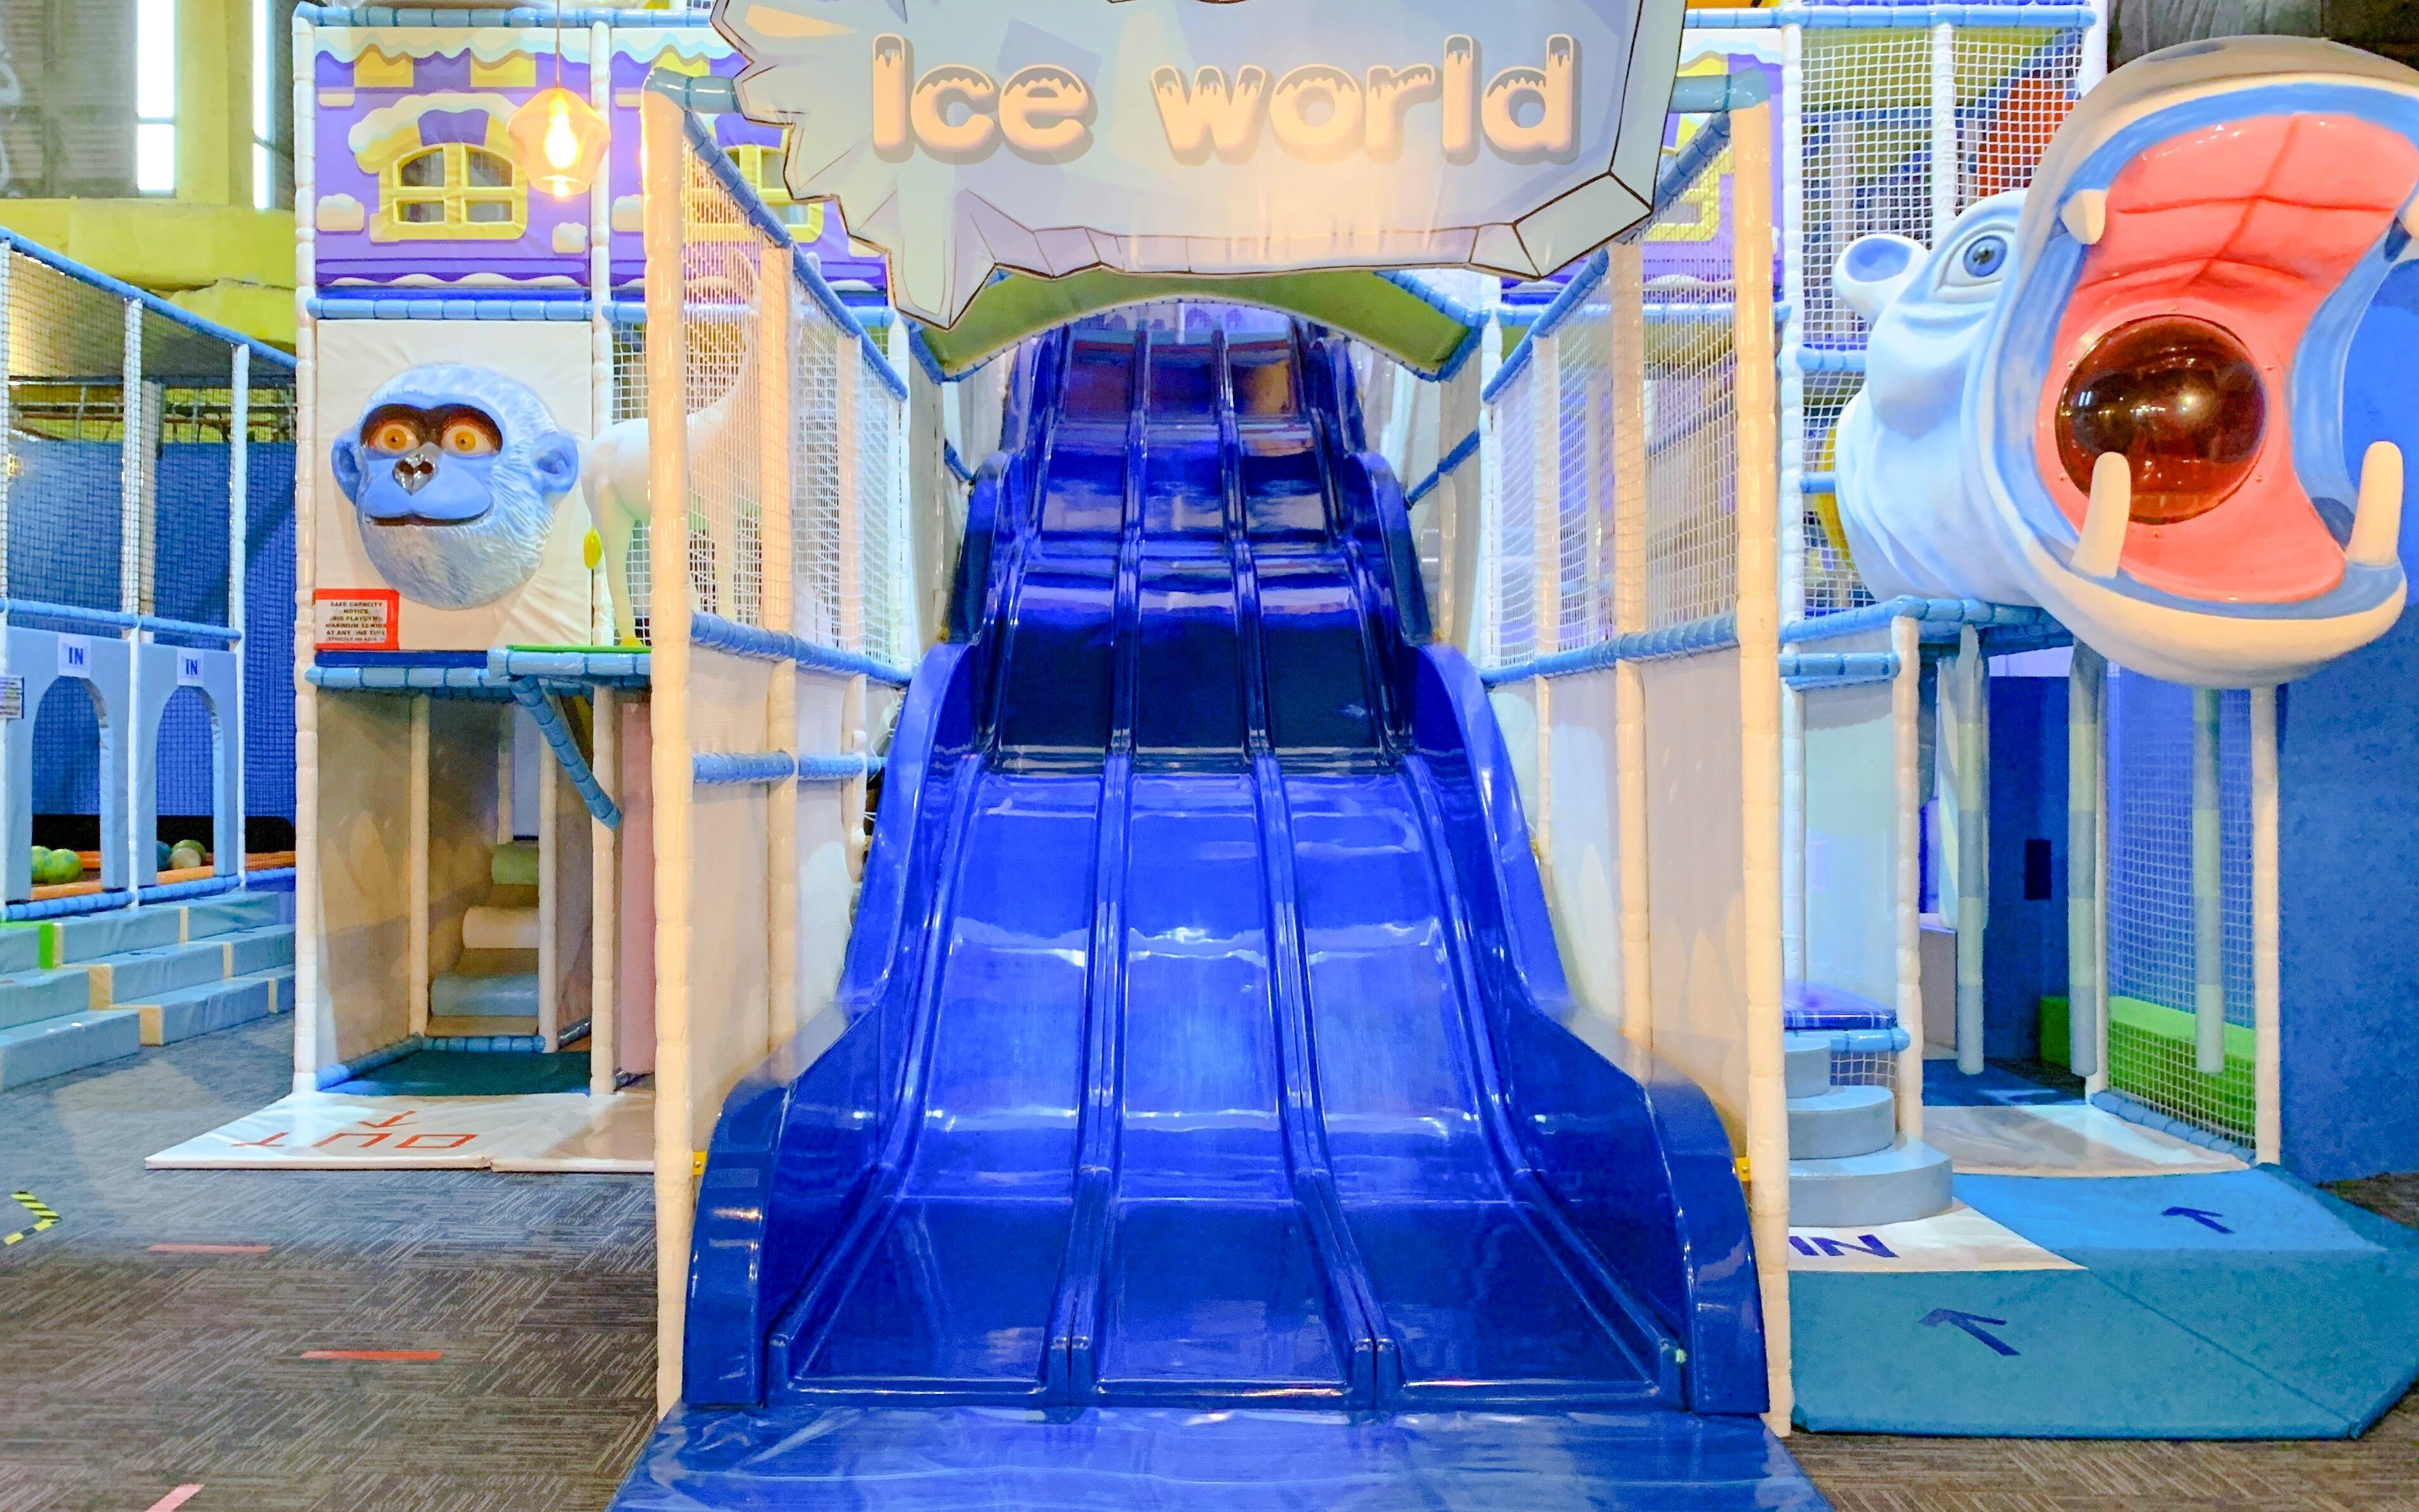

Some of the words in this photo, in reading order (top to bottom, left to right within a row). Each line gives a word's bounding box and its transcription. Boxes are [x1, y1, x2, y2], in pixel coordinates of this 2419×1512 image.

[871, 32, 1091, 155] Ice
[1150, 33, 1575, 155] world
[68, 646, 84, 665] IN
[185, 658, 198, 676] IN
[230, 1131, 478, 1148] OUT
[1789, 1234, 1901, 1258] IN
